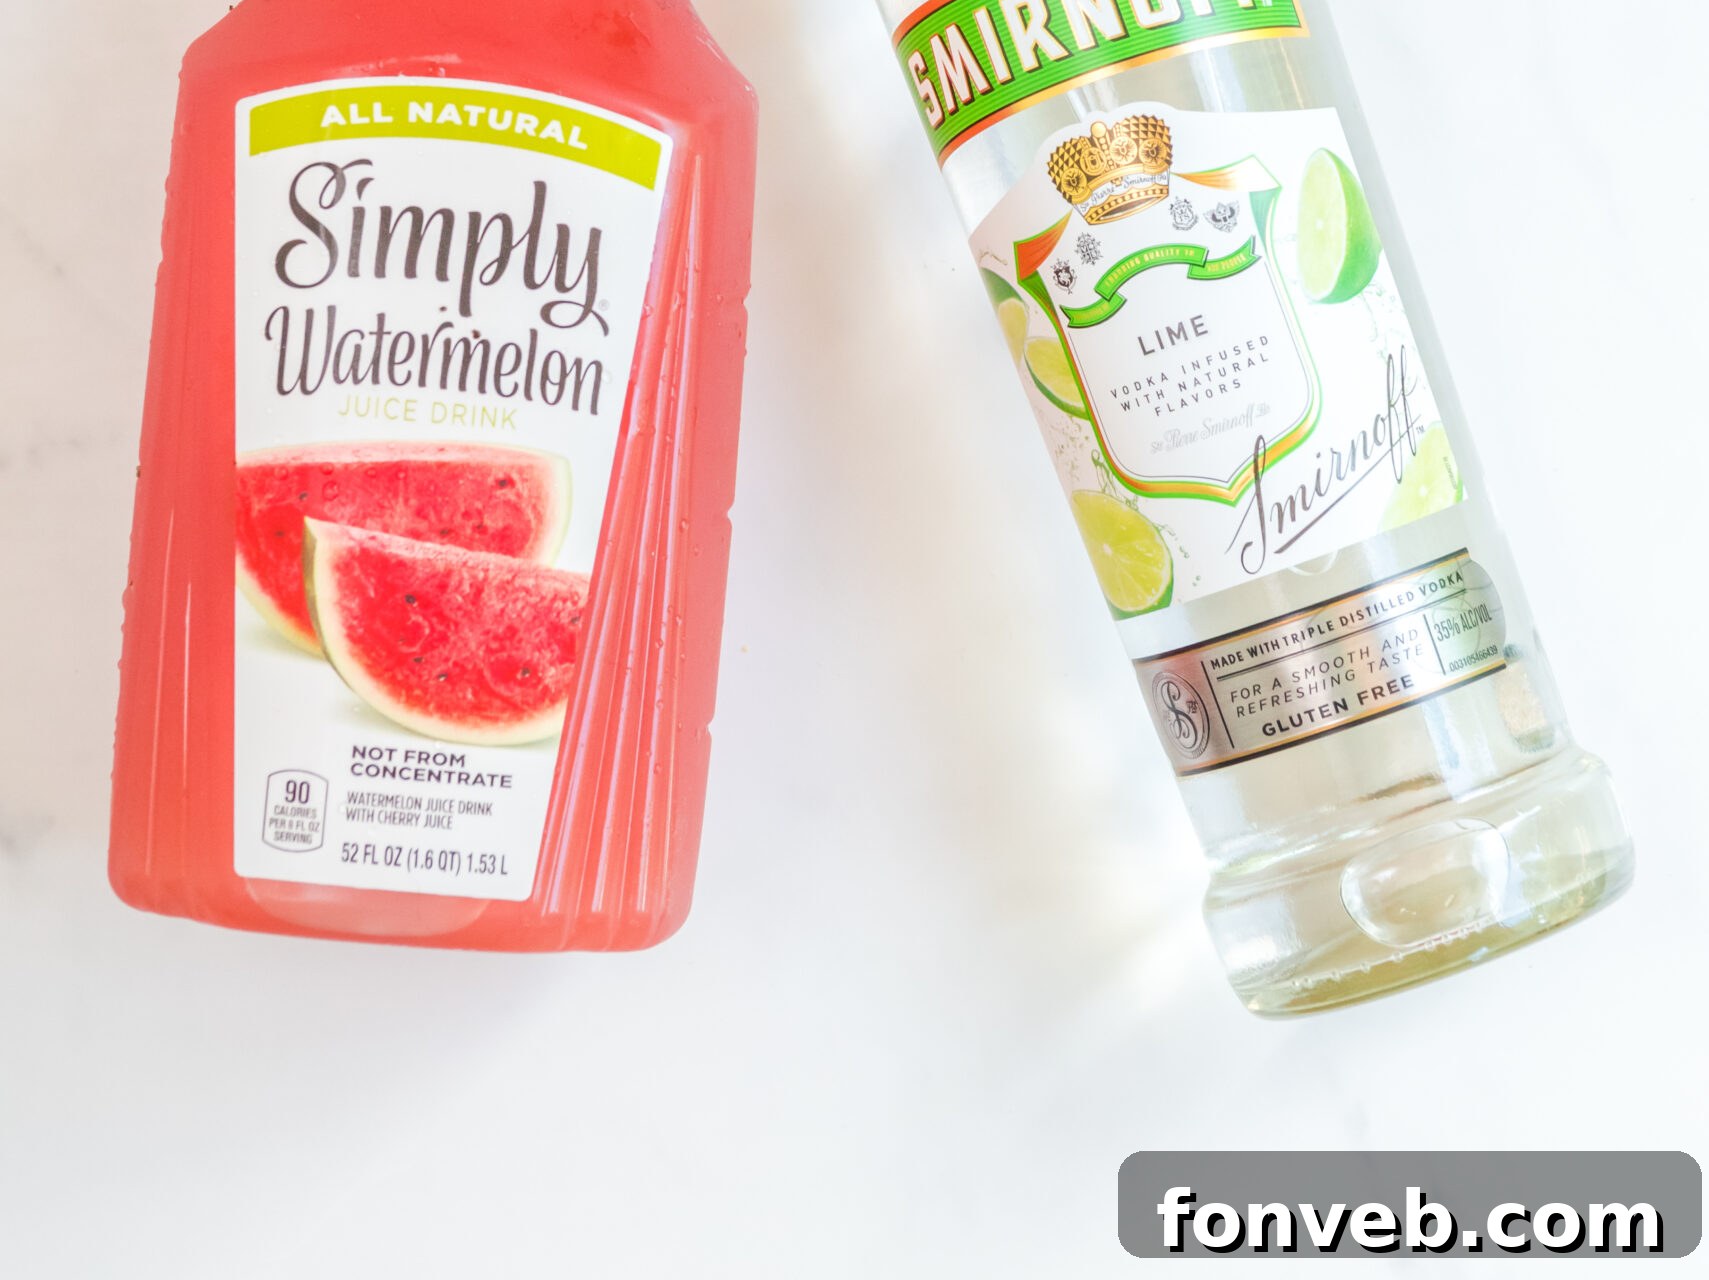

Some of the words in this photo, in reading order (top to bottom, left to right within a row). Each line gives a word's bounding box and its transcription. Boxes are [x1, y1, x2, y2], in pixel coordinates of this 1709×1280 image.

[320, 102, 393, 128] ALL
[408, 102, 588, 151] NATURAL
[275, 158, 609, 337] Simply
[1137, 314, 1209, 356] LIME
[264, 304, 602, 415] Watermelon
[1110, 371, 1169, 400] VODKA
[1181, 335, 1270, 375] INFUSED
[1120, 388, 1166, 413] WITH
[1178, 352, 1270, 392] NATURAL
[1154, 378, 1242, 417] FLAVORS
[338, 394, 417, 422] JUICE
[431, 401, 518, 430] DRINK
[1224, 344, 1422, 575] Smirnoff
[1210, 650, 1244, 670] MADE
[1246, 639, 1281, 659] WITH
[1282, 620, 1335, 648] TRIPLE
[1338, 590, 1415, 627] DISTILLED
[1419, 571, 1463, 596] VODKA
[1434, 617, 1461, 642] 35%
[1460, 603, 1493, 632] ALC/VOL
[1230, 684, 1262, 704] FOR
[1271, 678, 1283, 691] A
[1292, 647, 1371, 685] SMOOTH
[1381, 629, 1420, 650] AND
[1236, 669, 1356, 718] REFRESHING
[1366, 643, 1424, 675] TASTE
[1261, 697, 1349, 737] GLUTEN
[1357, 674, 1415, 706] FREE
[351, 763, 513, 789] CONCENTRATE
[352, 745, 397, 762] NOT
[404, 750, 466, 768] FROM
[285, 779, 310, 805] 90
[347, 791, 422, 810] WATERMELON
[425, 797, 454, 814] JUICE
[458, 800, 493, 816] DRINK
[269, 817, 286, 829] PER
[308, 821, 321, 832] OZ
[273, 805, 317, 819] CALORIES
[345, 807, 374, 823] WITH
[377, 810, 420, 828] CHERRY
[423, 814, 453, 830] JUICE
[274, 831, 313, 845] SERVING
[341, 842, 358, 864] 52
[363, 845, 379, 865] FL
[384, 846, 402, 868] OZ
[407, 848, 434, 873] (1.6
[438, 851, 461, 876] QT)
[467, 854, 496, 874] 1.53
[500, 855, 508, 875] L
